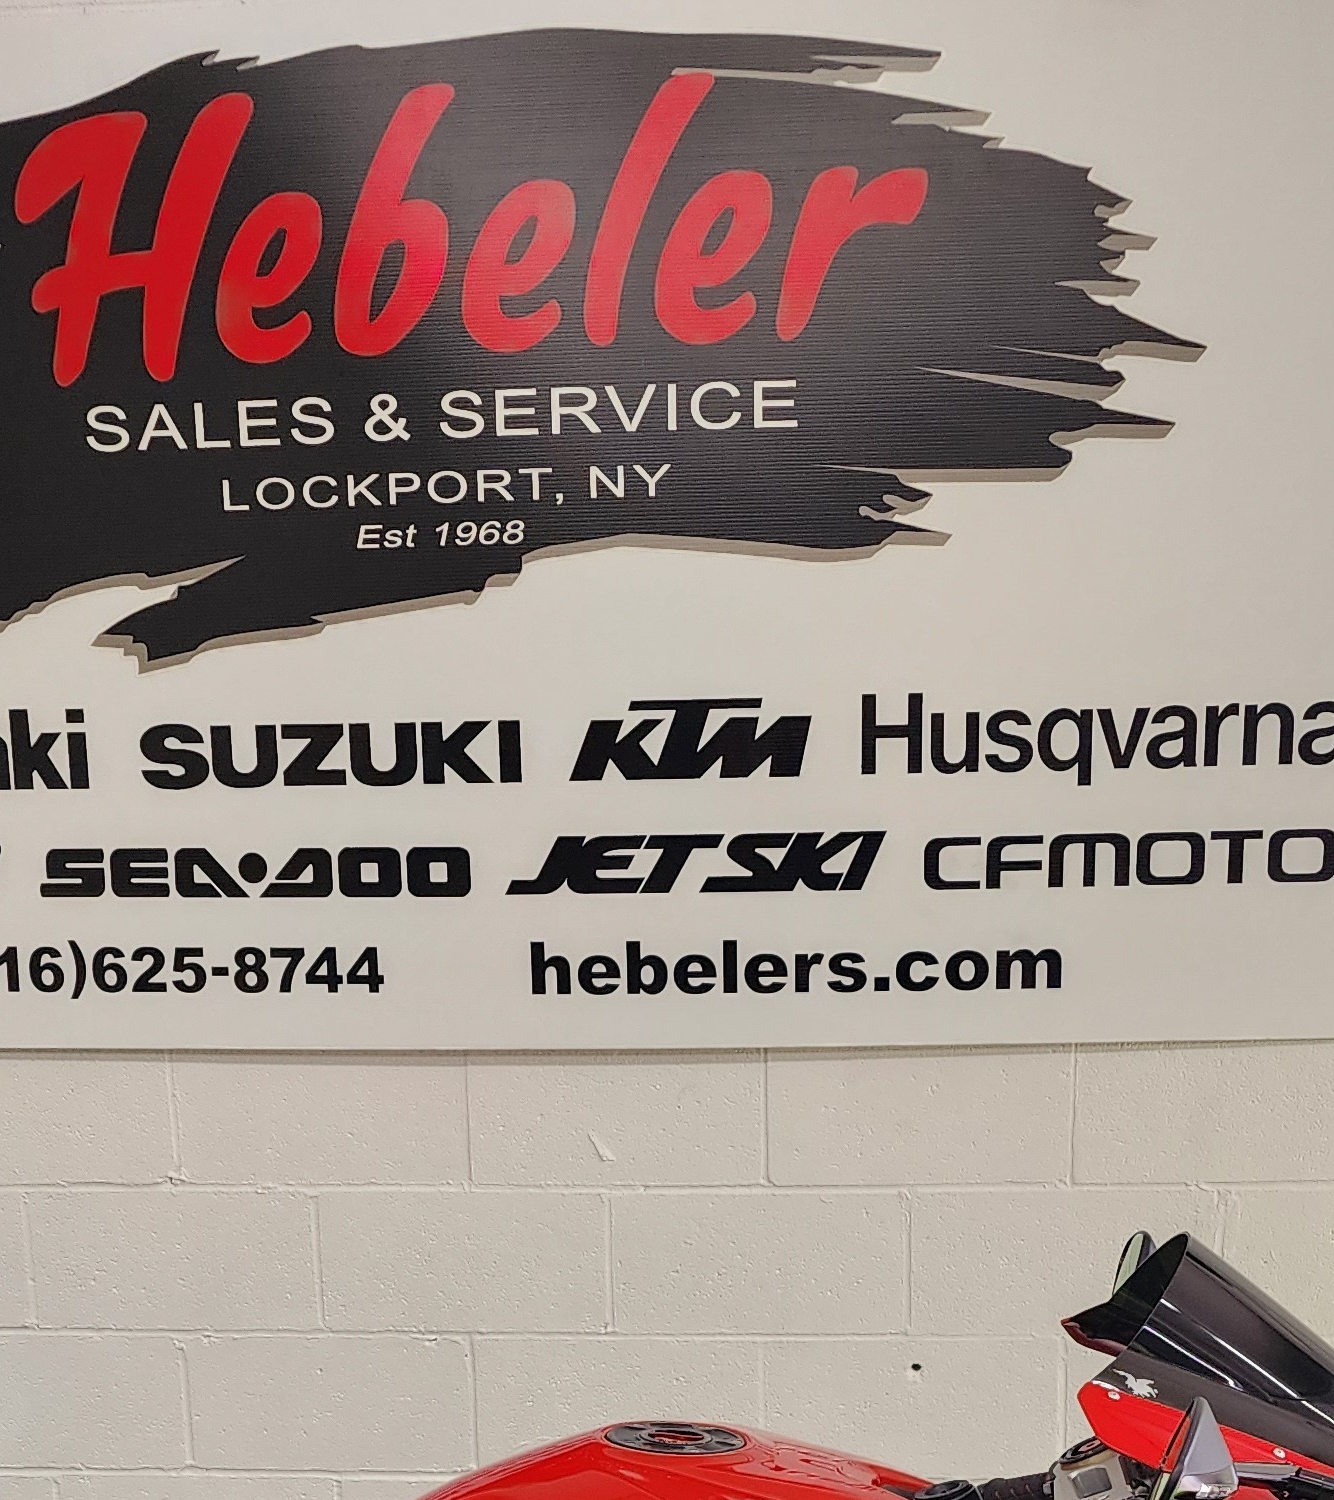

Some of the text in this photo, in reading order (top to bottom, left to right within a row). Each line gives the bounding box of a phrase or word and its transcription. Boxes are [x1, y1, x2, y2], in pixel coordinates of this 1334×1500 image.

[14, 73, 926, 388] Hebeler
[86, 379, 799, 453] SALES & SERVICE
[222, 463, 672, 511] LOCKPORT, NY
[356, 519, 526, 550] Est 1968
[139, 719, 523, 790] SUZUKI
[568, 697, 813, 783] KTM
[529, 938, 1063, 996] hebelers.com
